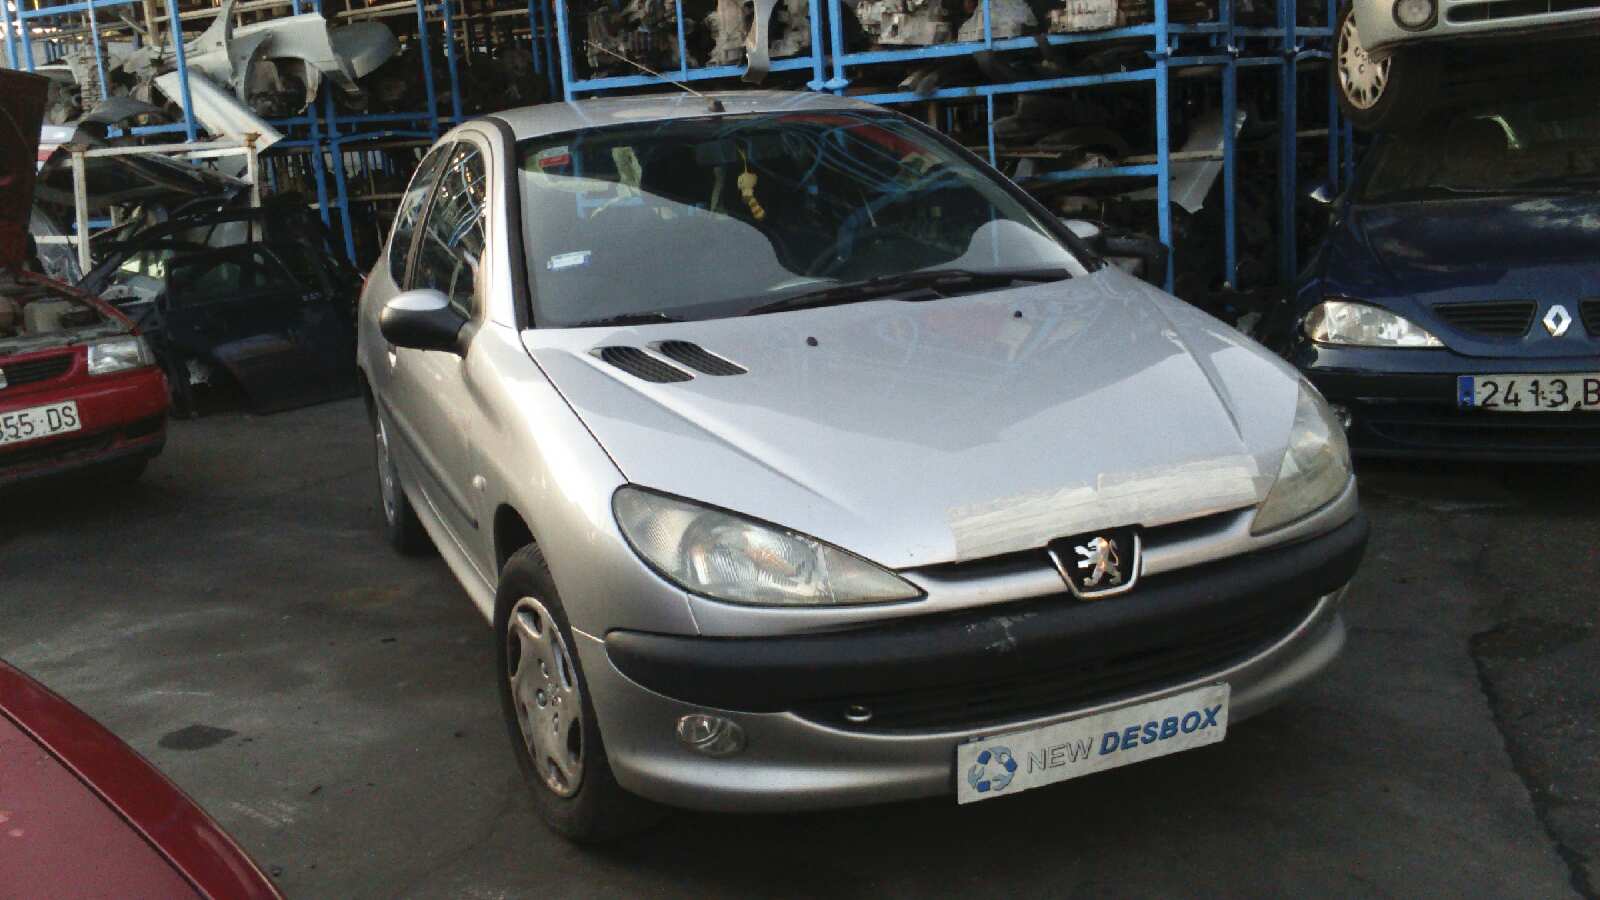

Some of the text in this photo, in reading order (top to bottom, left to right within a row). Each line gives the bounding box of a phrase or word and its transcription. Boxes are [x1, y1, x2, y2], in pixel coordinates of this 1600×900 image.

[1481, 379, 1568, 407] 2413
[0, 405, 76, 440] 55 DS
[1026, 704, 1222, 774] NEW DESBOX
